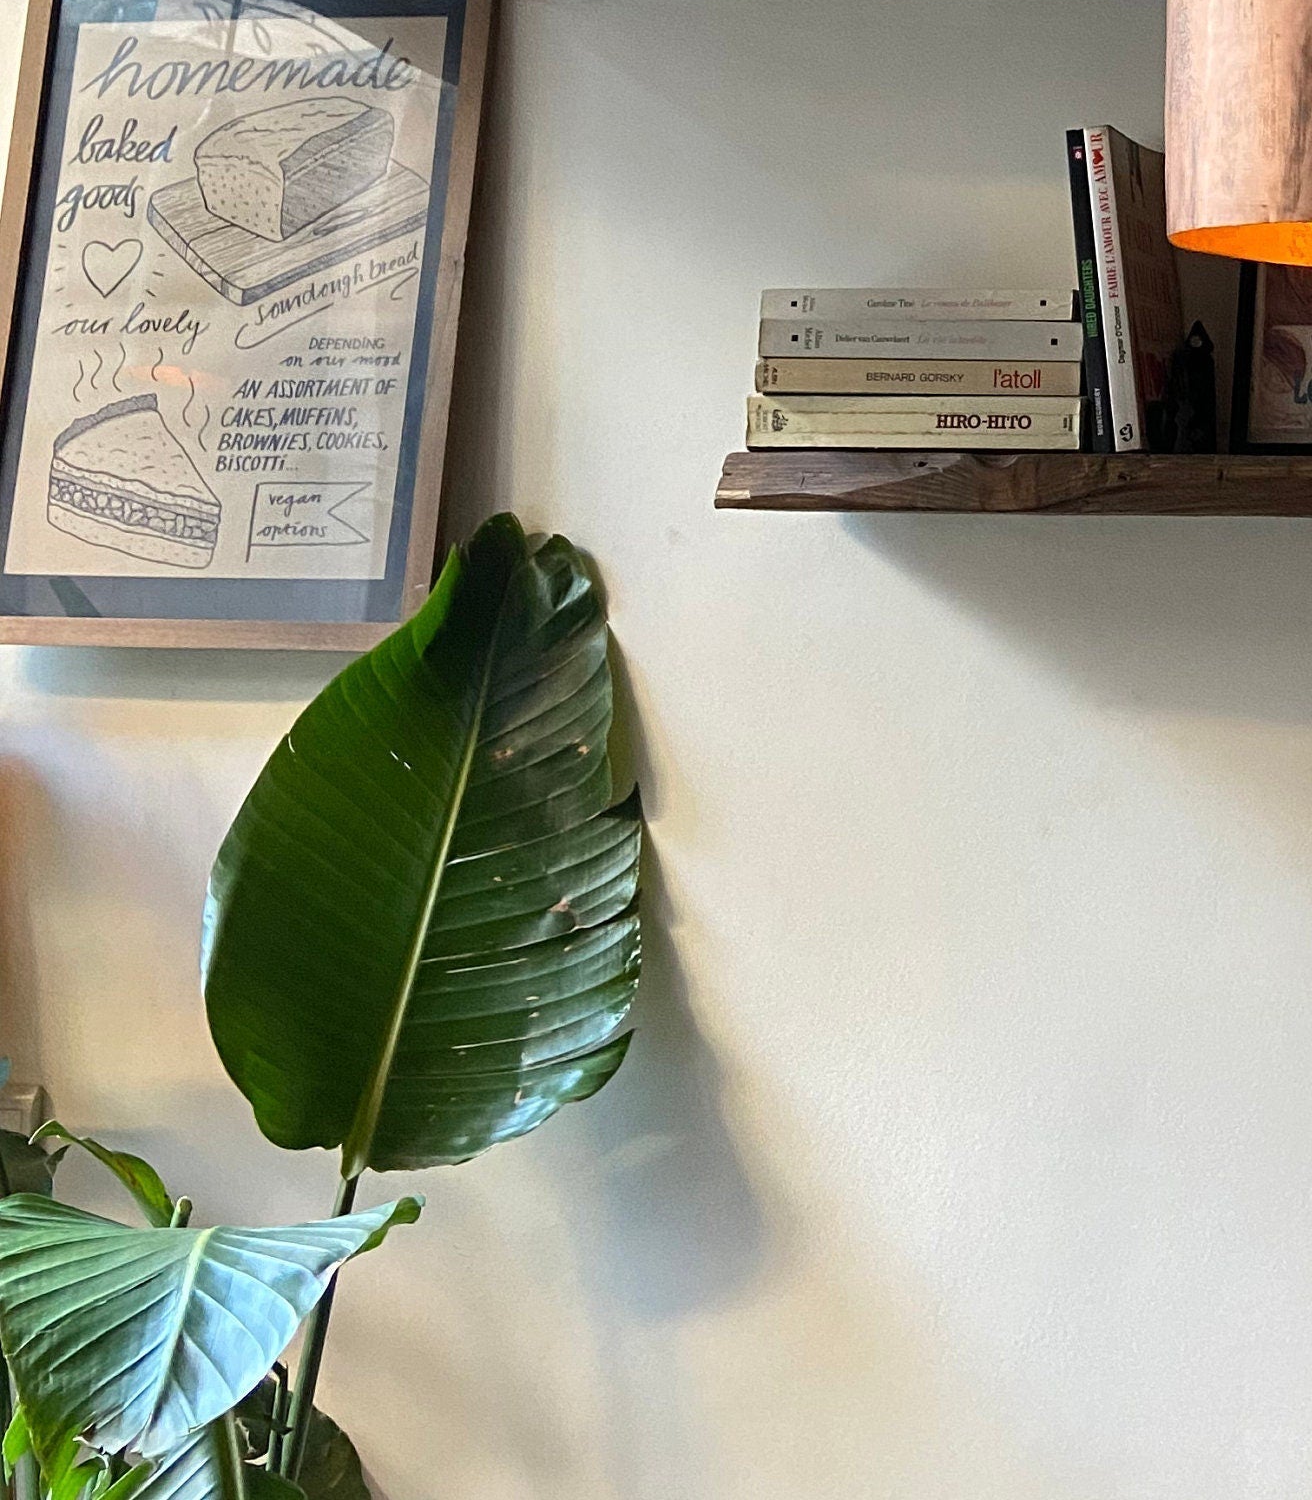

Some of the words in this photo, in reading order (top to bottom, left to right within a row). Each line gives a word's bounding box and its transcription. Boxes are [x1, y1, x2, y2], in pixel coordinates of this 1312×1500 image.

[80, 35, 413, 101] homemade
[68, 113, 177, 167] baked
[55, 175, 144, 233] goods
[1098, 187, 1113, 215] AVEC
[1101, 217, 1117, 263] L'AMOUR
[256, 261, 362, 327] sourdough
[369, 241, 421, 280] bread
[1082, 258, 1094, 309] DAUGHTERS
[1108, 263, 1120, 299] FAIRE
[52, 316, 115, 337] our
[119, 301, 209, 355] lovely
[1085, 308, 1099, 338] HIRED
[1114, 305, 1124, 338] O'Connor
[308, 336, 385, 351] DEPENDING
[279, 356, 305, 368] on
[309, 355, 346, 368] our
[352, 351, 401, 368] mood
[233, 380, 260, 399] AN
[266, 378, 372, 399] ASSORTMENT
[375, 378, 398, 396] OF
[866, 371, 916, 383] BERNARD
[919, 372, 965, 384] GORSKY
[993, 368, 1042, 389] l'atoll
[936, 413, 1032, 430] HIRO-HITO
[268, 492, 322, 517] vegan
[256, 521, 329, 541] options
